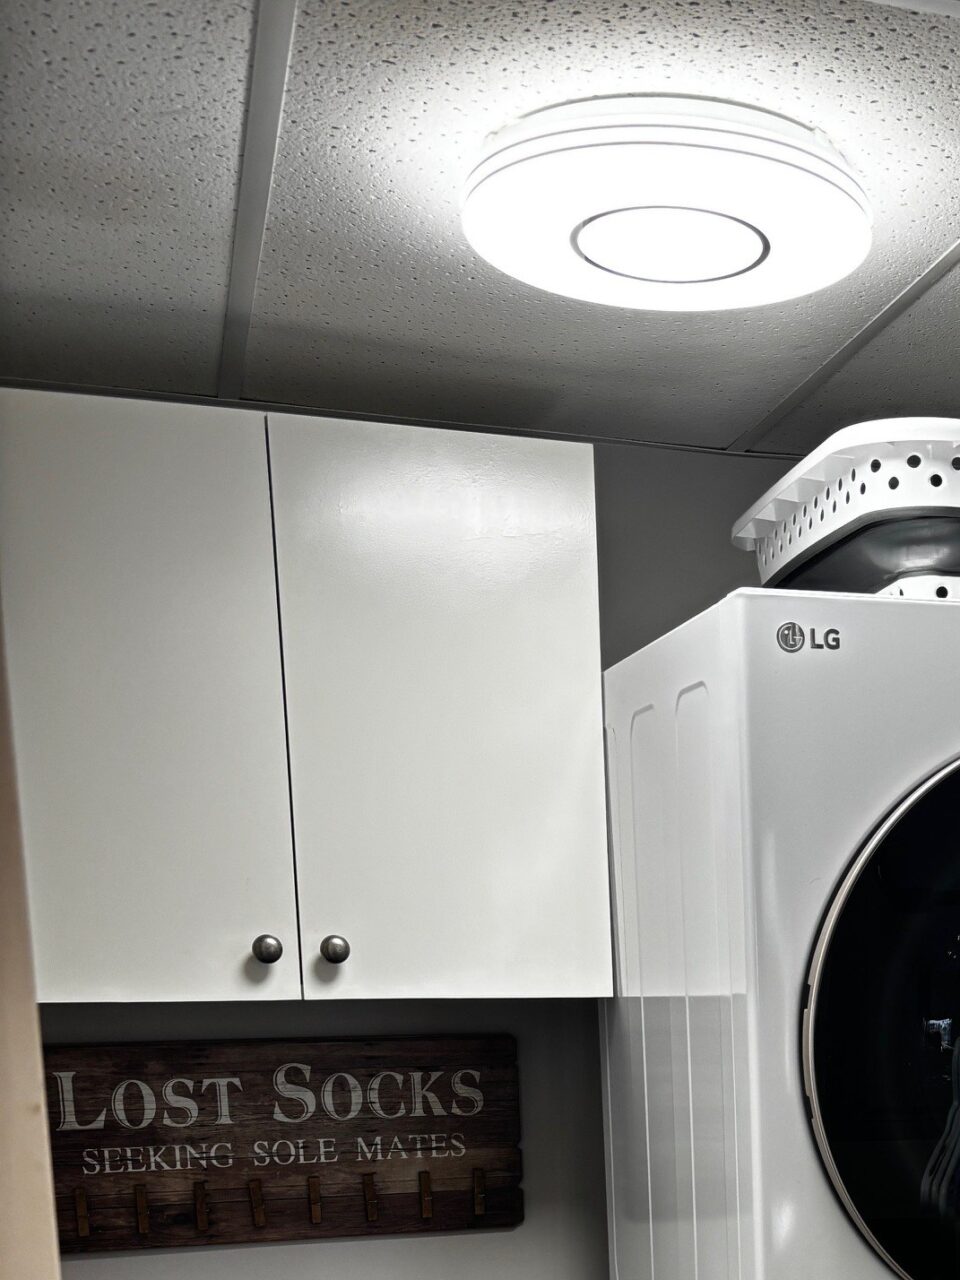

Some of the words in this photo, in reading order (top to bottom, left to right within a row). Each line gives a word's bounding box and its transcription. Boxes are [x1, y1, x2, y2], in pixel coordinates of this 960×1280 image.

[809, 627, 841, 650] LG
[52, 1070, 243, 1132] LOST
[271, 1062, 485, 1124] SOCKS
[82, 1142, 234, 1176] SEEKING
[253, 1137, 339, 1167] SOLE
[356, 1132, 467, 1163] MATES
